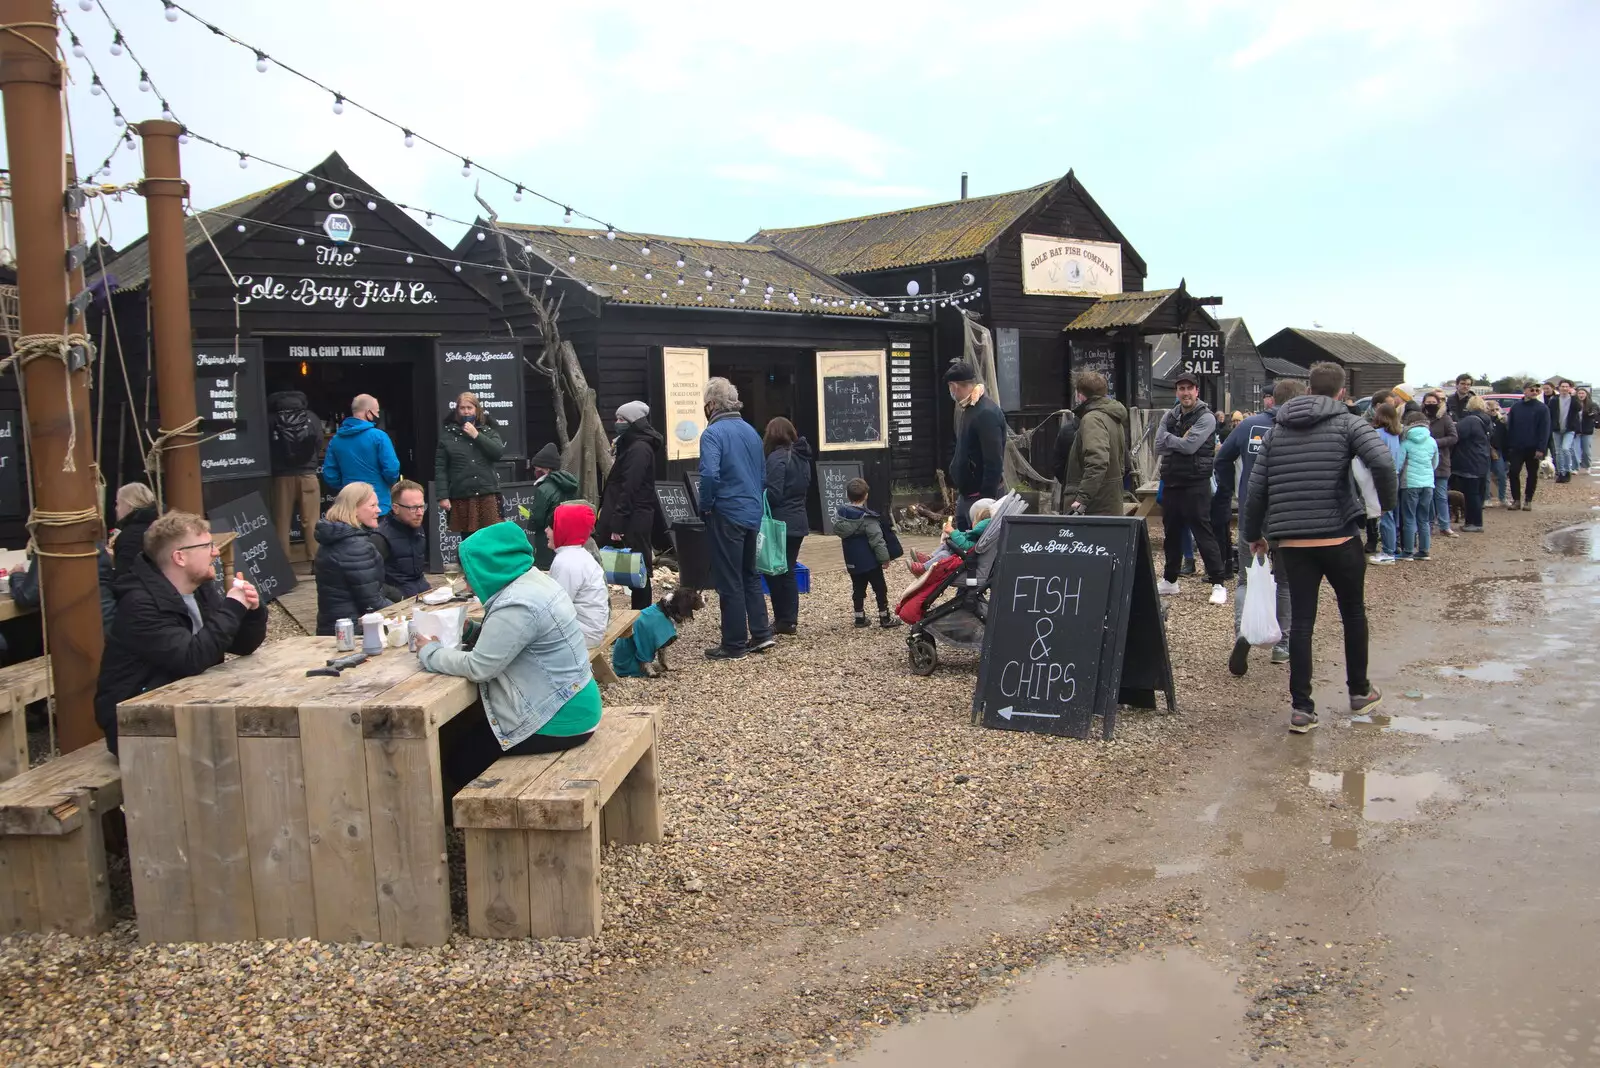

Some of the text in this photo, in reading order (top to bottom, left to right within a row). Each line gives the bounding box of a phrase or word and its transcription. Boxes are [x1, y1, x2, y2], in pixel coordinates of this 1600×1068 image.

[316, 245, 357, 267] The
[1030, 246, 1114, 276] SOLE BAY FISH COMPANY
[233, 275, 438, 308] Sole Bay Fish Co.
[1188, 334, 1219, 348] FISH
[289, 346, 386, 357] FISH & CHIP TAKE AWAY
[445, 351, 515, 362] Sole Bay Specials
[1192, 349, 1214, 359] FOR
[1184, 361, 1221, 374] SALE
[468, 373, 492, 381] Oysters
[469, 382, 492, 390] Lobster
[835, 380, 860, 394] Fresh
[479, 391, 495, 399] Bass
[440, 532, 462, 542] Peron
[1059, 529, 1075, 538] The
[241, 541, 268, 560] ausage
[1020, 541, 1043, 554] Sole
[1045, 540, 1068, 553] Bay
[1069, 541, 1094, 555] Fish
[249, 560, 261, 576] nd
[253, 576, 278, 595] hips
[1013, 576, 1082, 615] FISH
[1029, 617, 1053, 661] &
[1000, 661, 1076, 702] CHIPS
